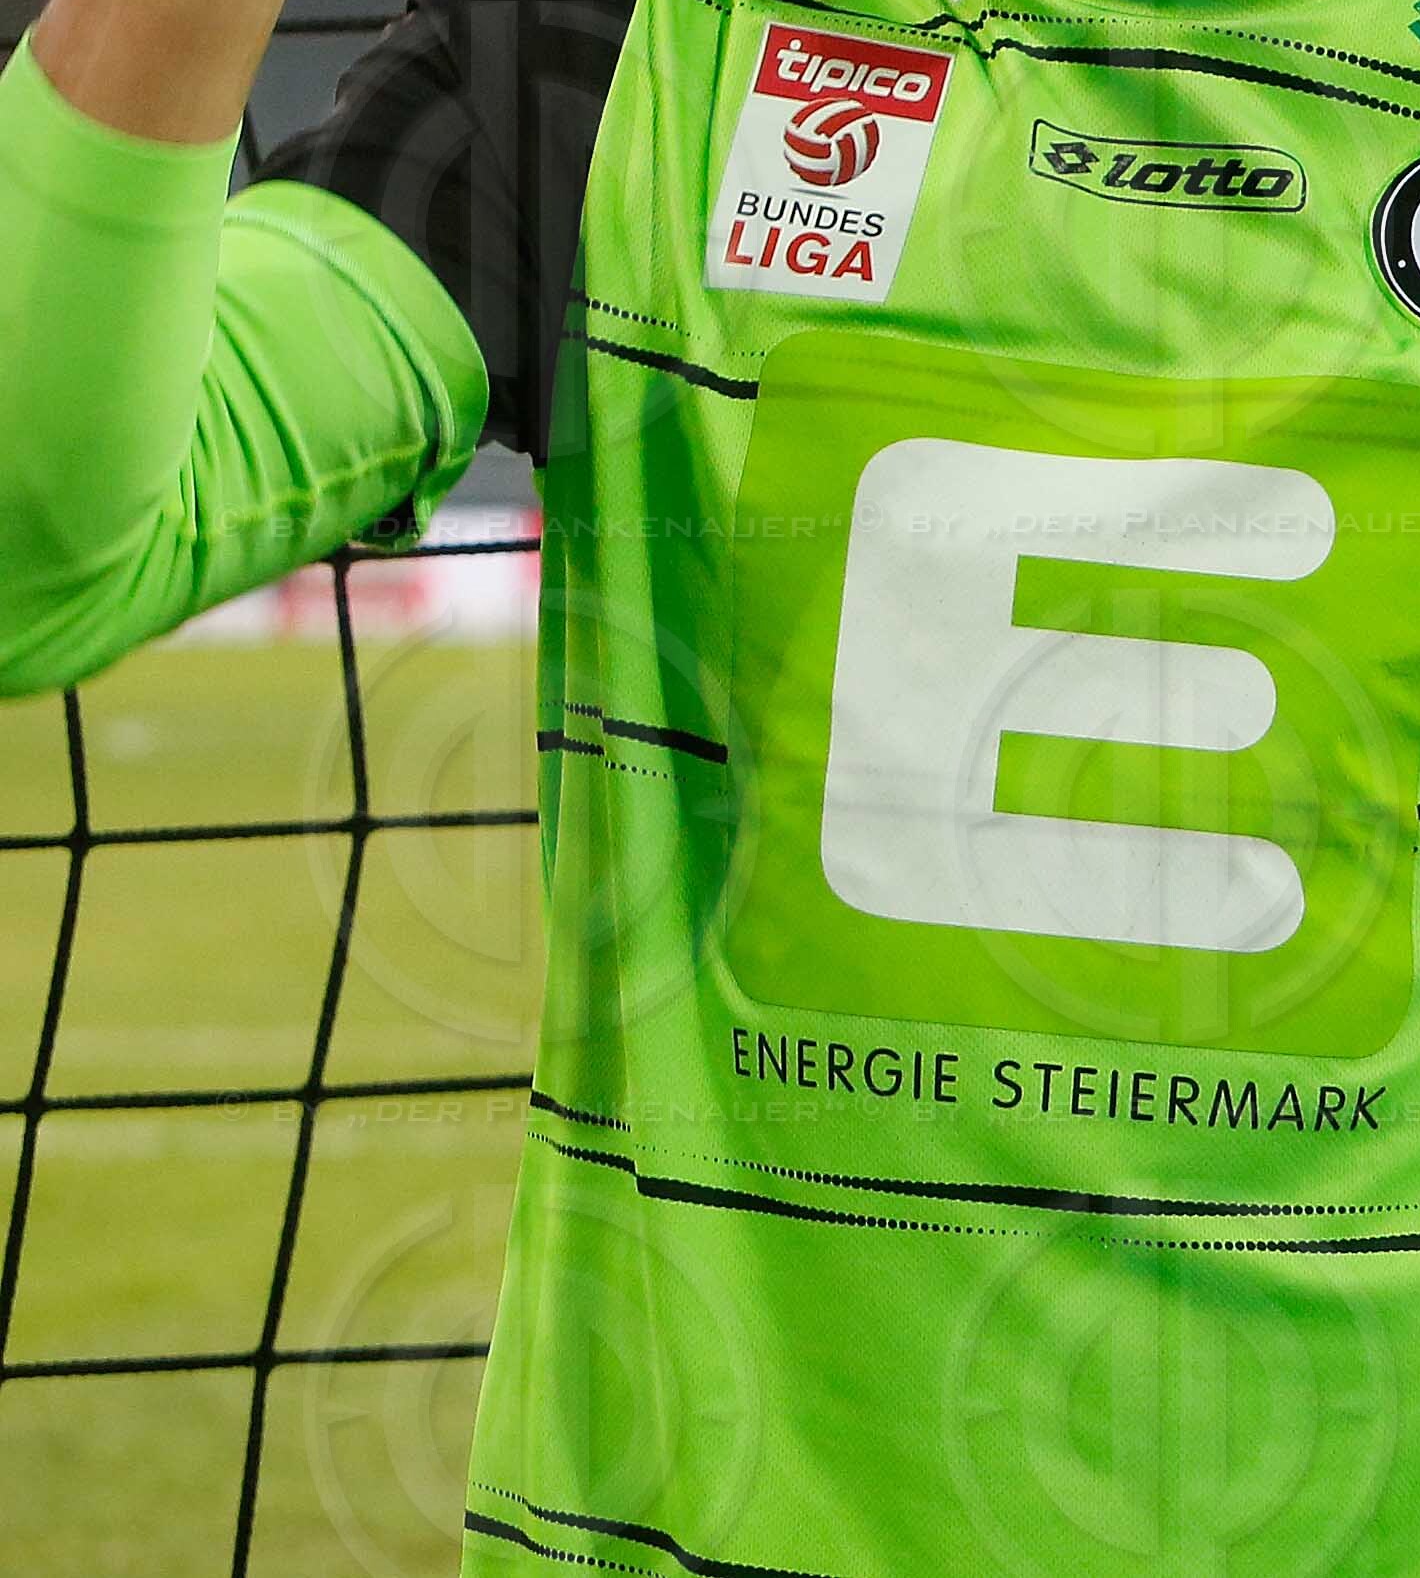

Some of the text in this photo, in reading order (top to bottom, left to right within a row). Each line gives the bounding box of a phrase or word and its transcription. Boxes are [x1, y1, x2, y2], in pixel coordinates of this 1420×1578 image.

[777, 40, 932, 102] tipico
[1102, 157, 1293, 198] lotto
[737, 192, 884, 237] BUNDES
[723, 221, 874, 281] LIGA
[820, 436, 1336, 954] E
[731, 1027, 1387, 1132] ENERGIE STEIERMARK
